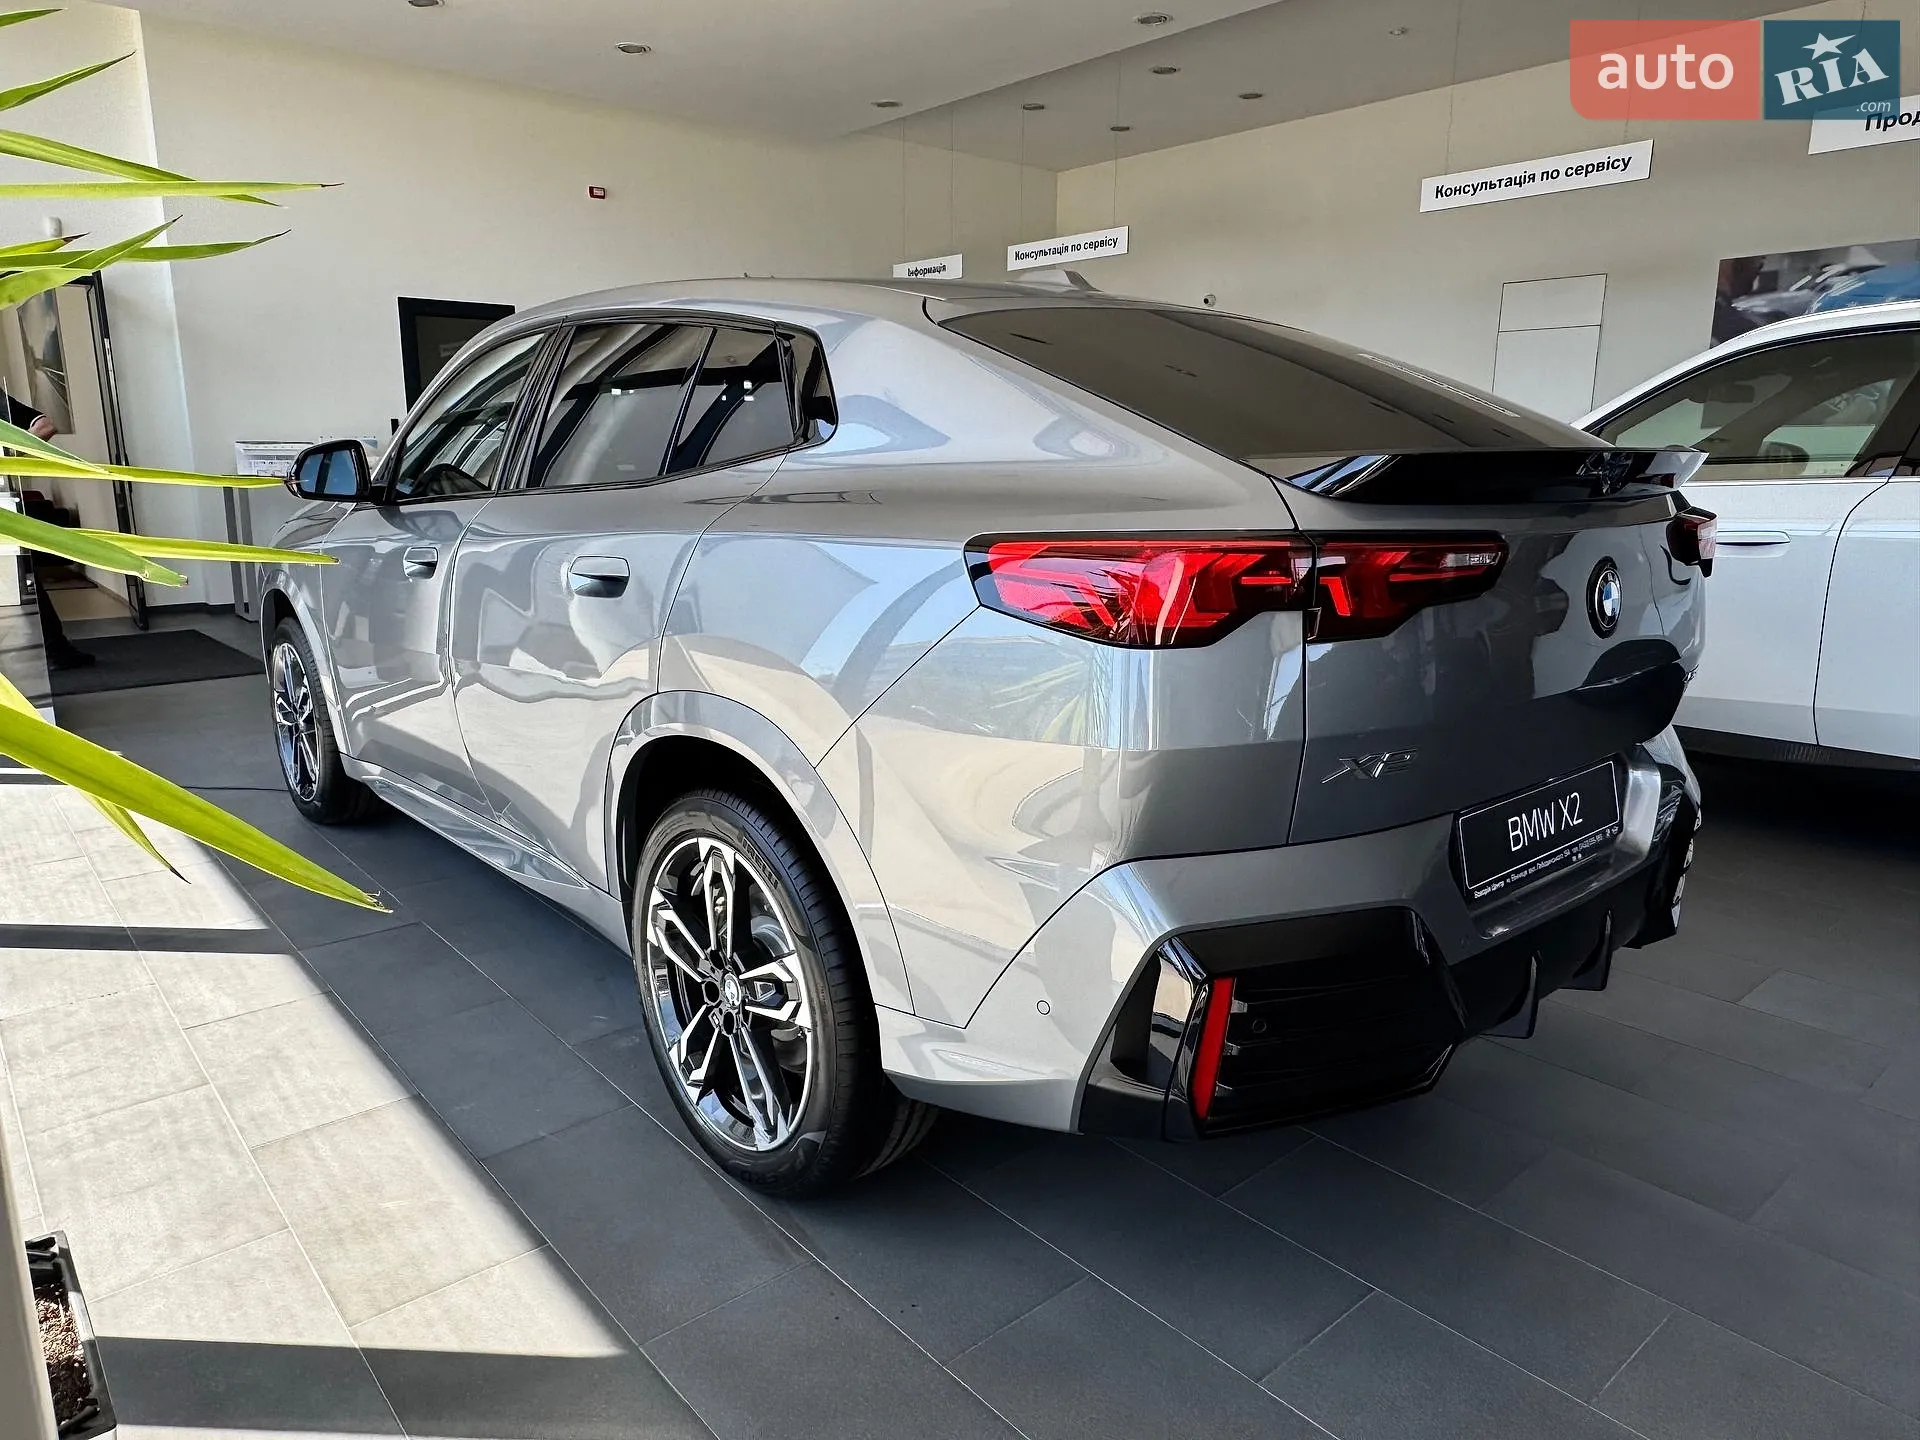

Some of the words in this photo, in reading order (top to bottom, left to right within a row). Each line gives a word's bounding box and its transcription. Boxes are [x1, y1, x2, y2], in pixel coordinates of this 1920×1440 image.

[1435, 170, 1536, 199] Консультація
[1540, 167, 1560, 182] по
[1564, 155, 1633, 178] сервісу
[1014, 243, 1069, 261] Консультація
[1070, 243, 1082, 253] по
[1083, 236, 1119, 251] сервісу
[1507, 801, 1556, 852] BMW
[1558, 792, 1584, 831] X2
